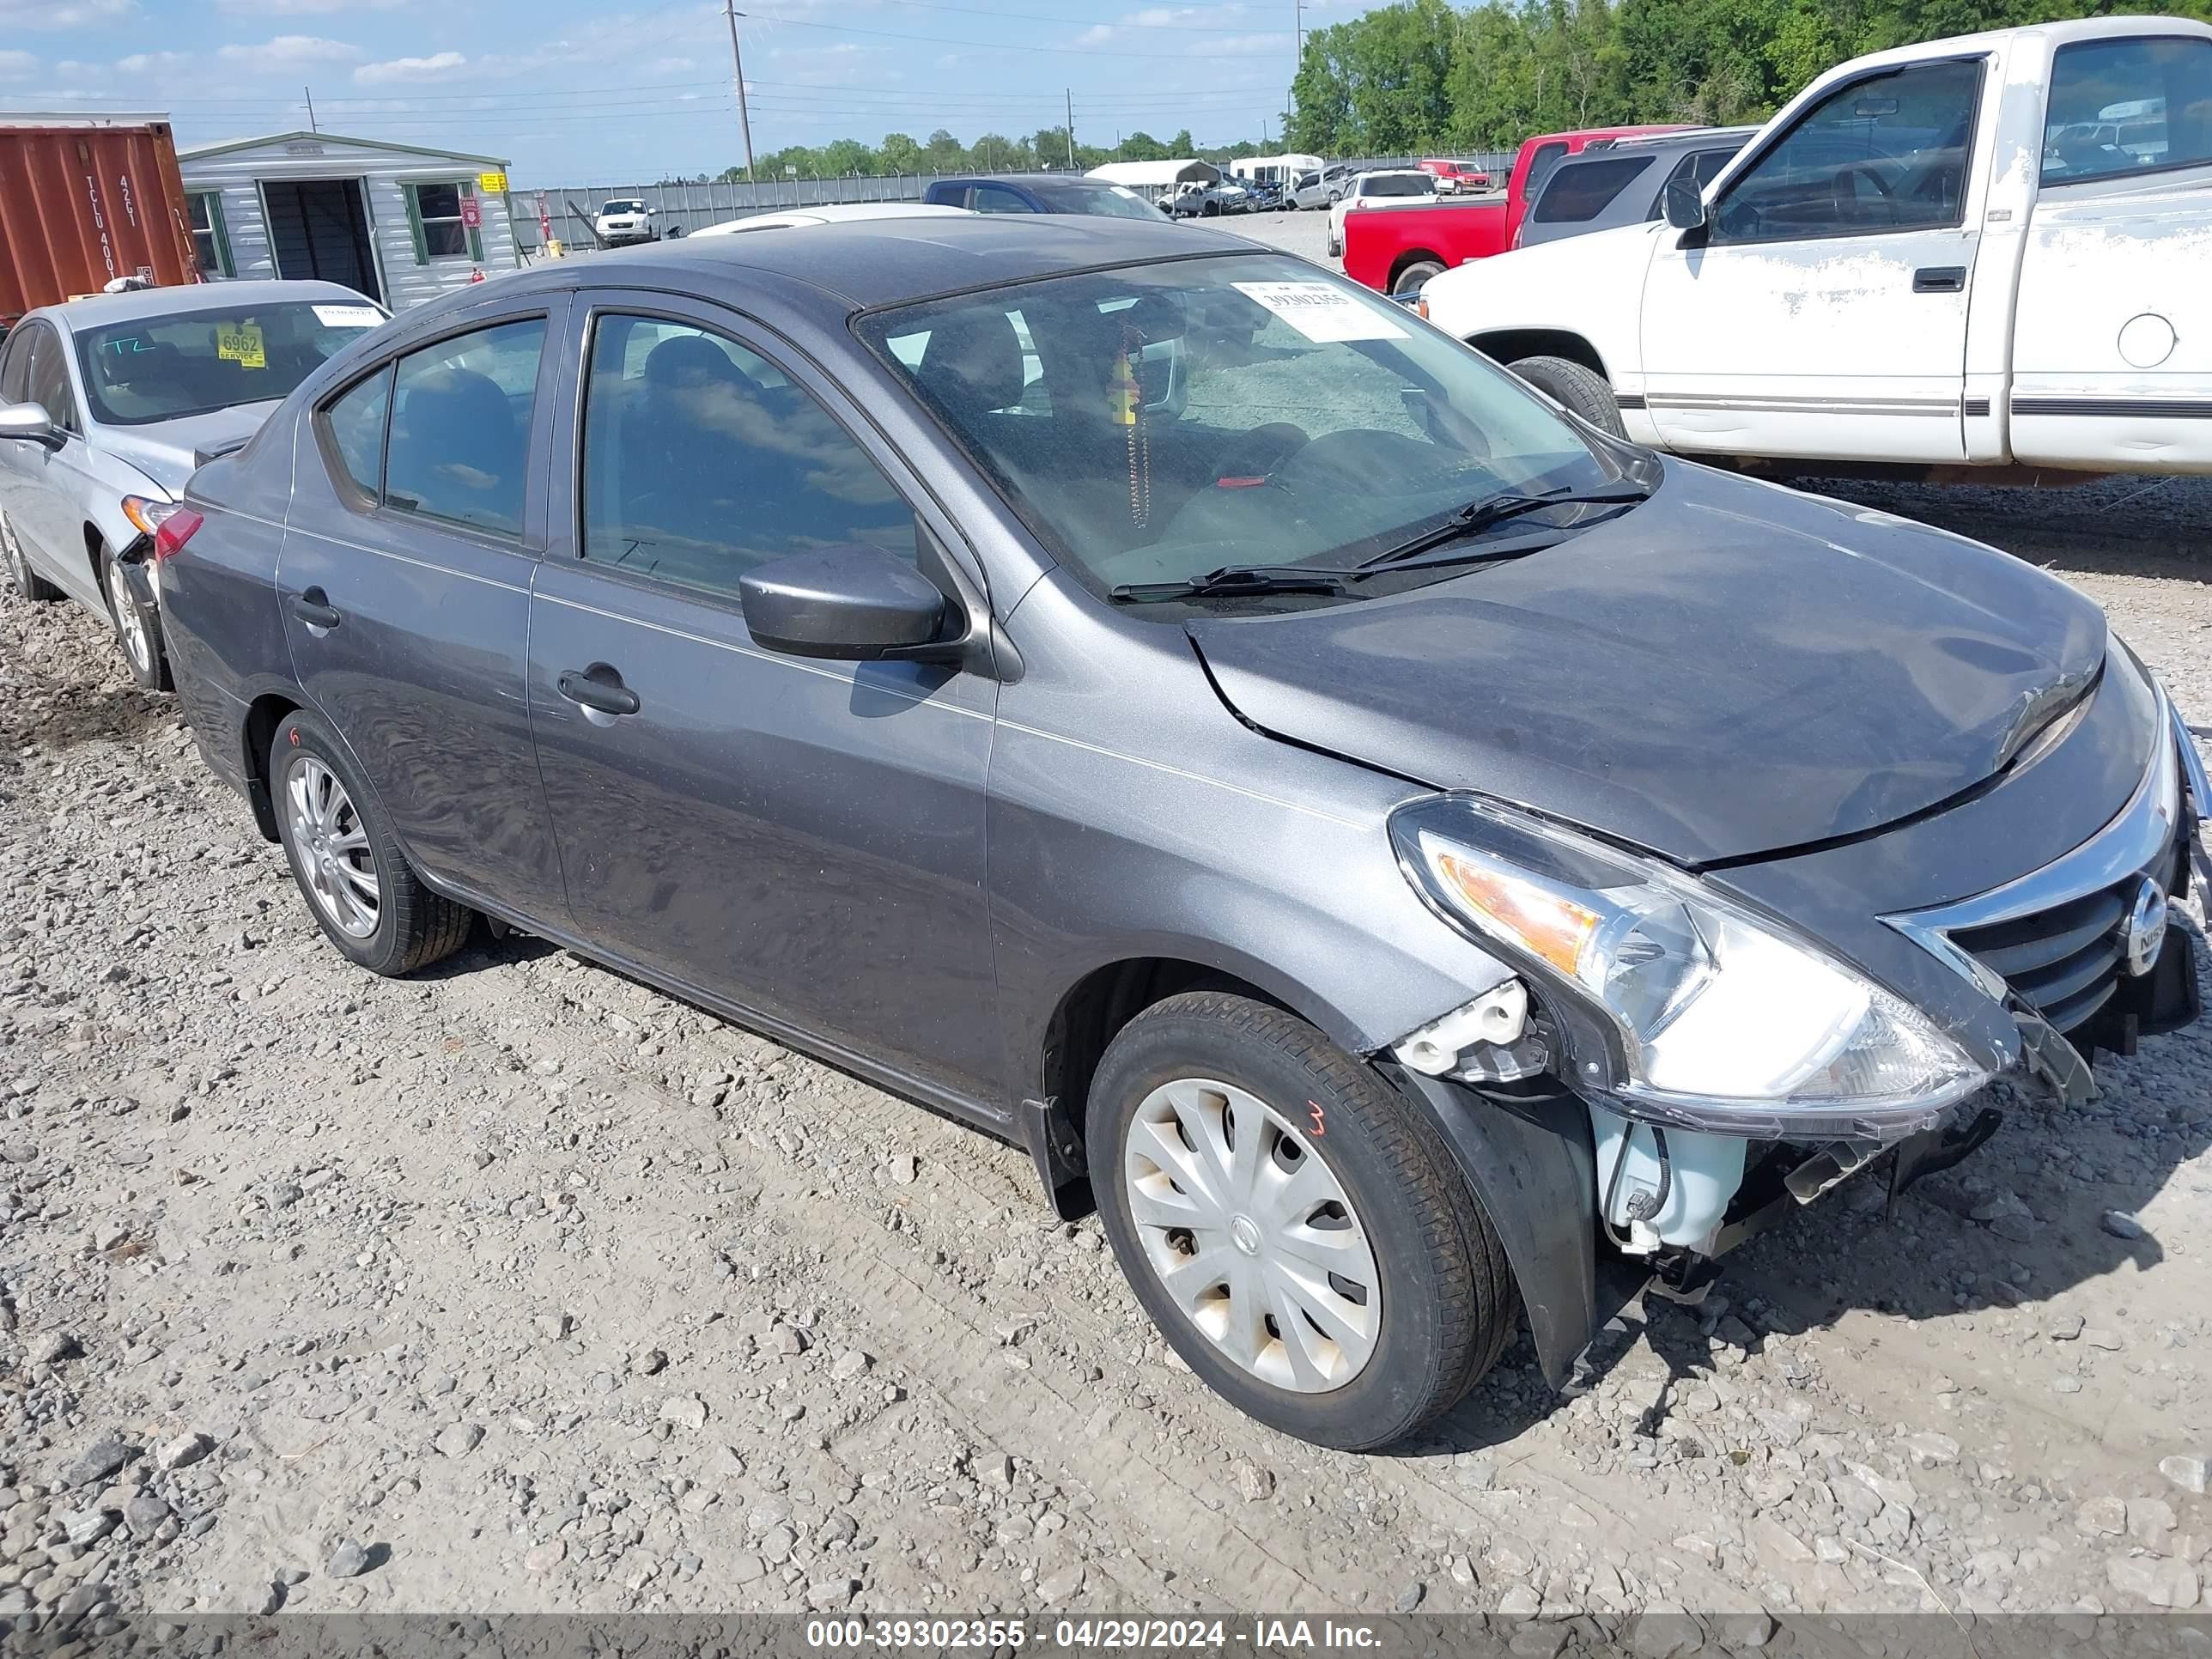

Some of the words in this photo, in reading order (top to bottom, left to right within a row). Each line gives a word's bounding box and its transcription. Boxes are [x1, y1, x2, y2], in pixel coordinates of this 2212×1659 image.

[86, 176, 104, 228] TCLU
[120, 175, 135, 227] 42G1
[1264, 295, 1349, 307] 39302355
[223, 335, 258, 352] 6962
[290, 727, 300, 747] 6
[1308, 1099, 1325, 1135] 3
